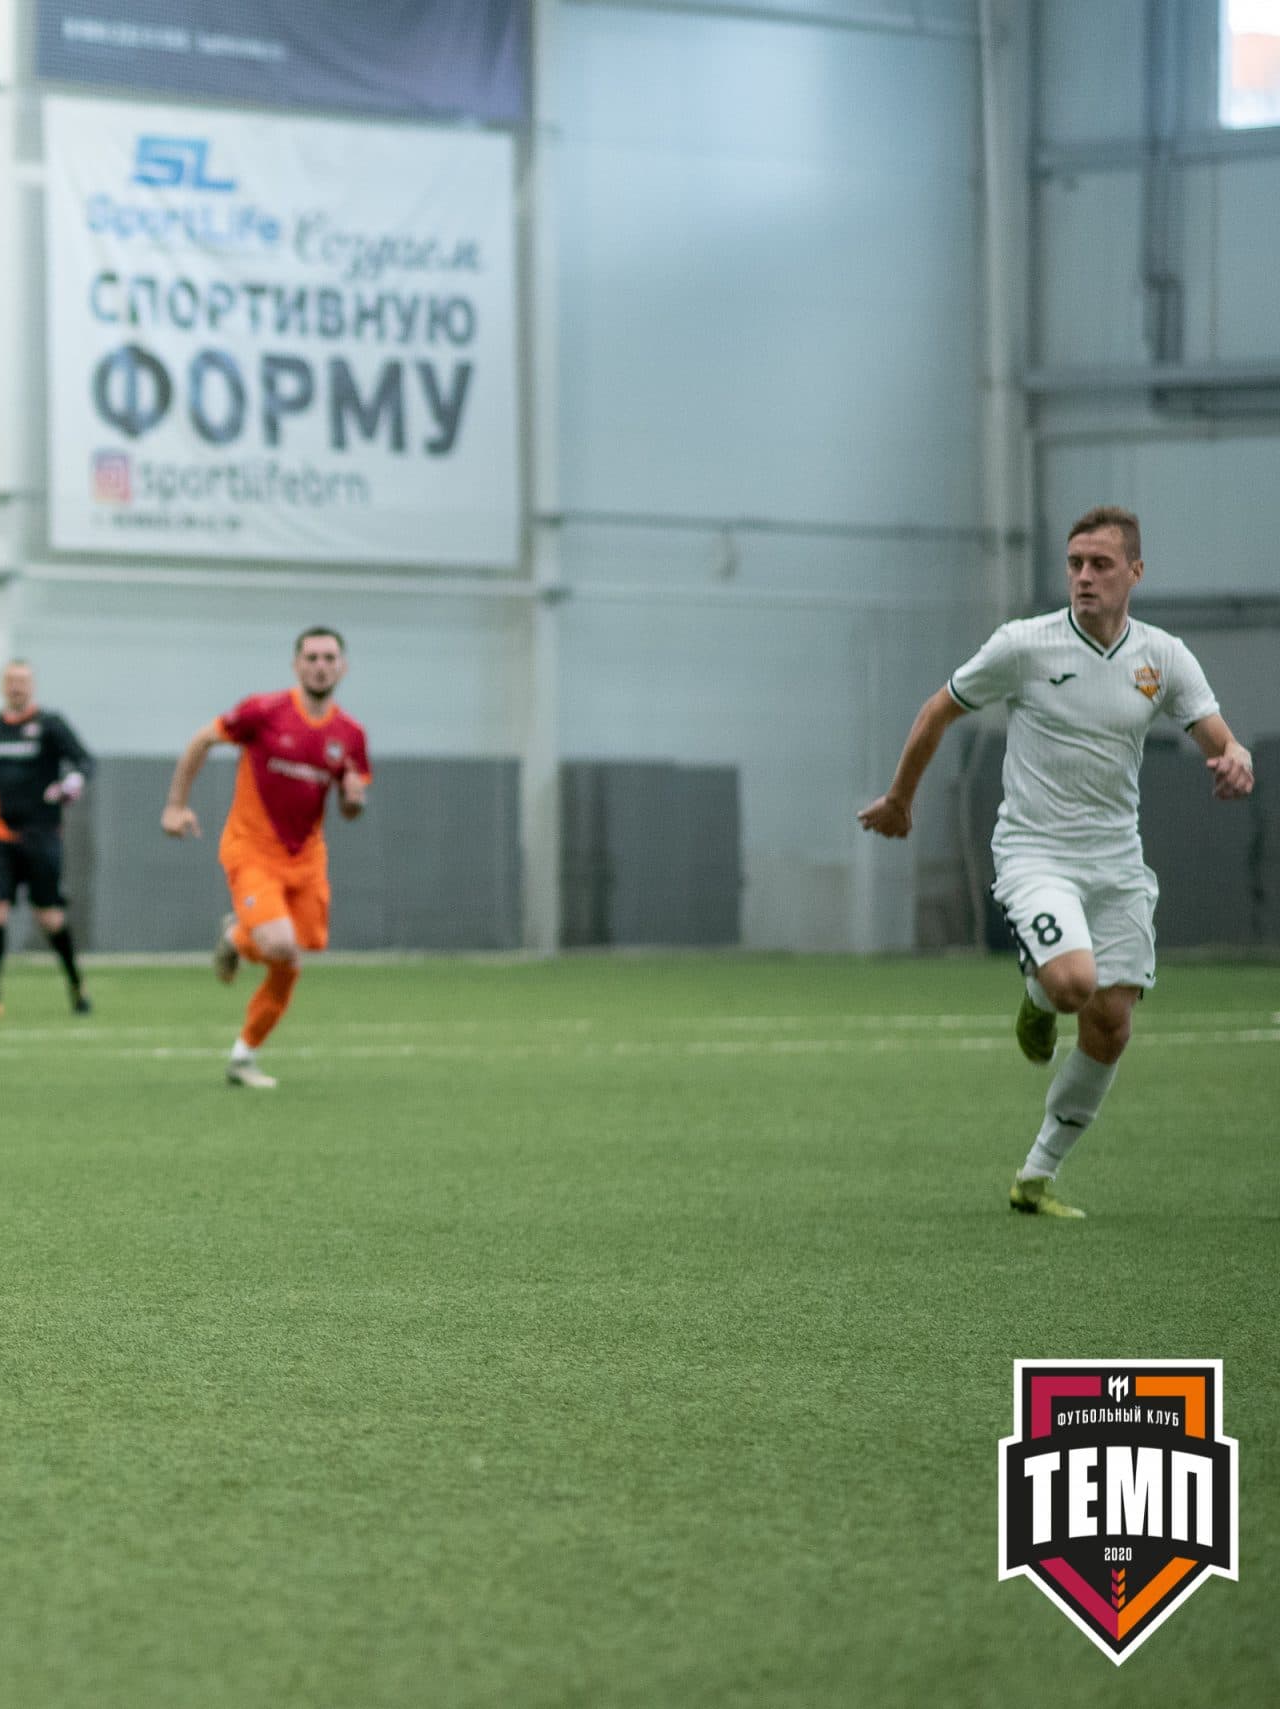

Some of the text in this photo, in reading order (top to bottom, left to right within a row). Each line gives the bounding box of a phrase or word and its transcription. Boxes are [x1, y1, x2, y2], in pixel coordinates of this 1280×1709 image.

[89, 269, 478, 347] СПОРТИВНУЮ
[91, 342, 475, 457] ФОРМУ
[1031, 912, 1063, 946] 8
